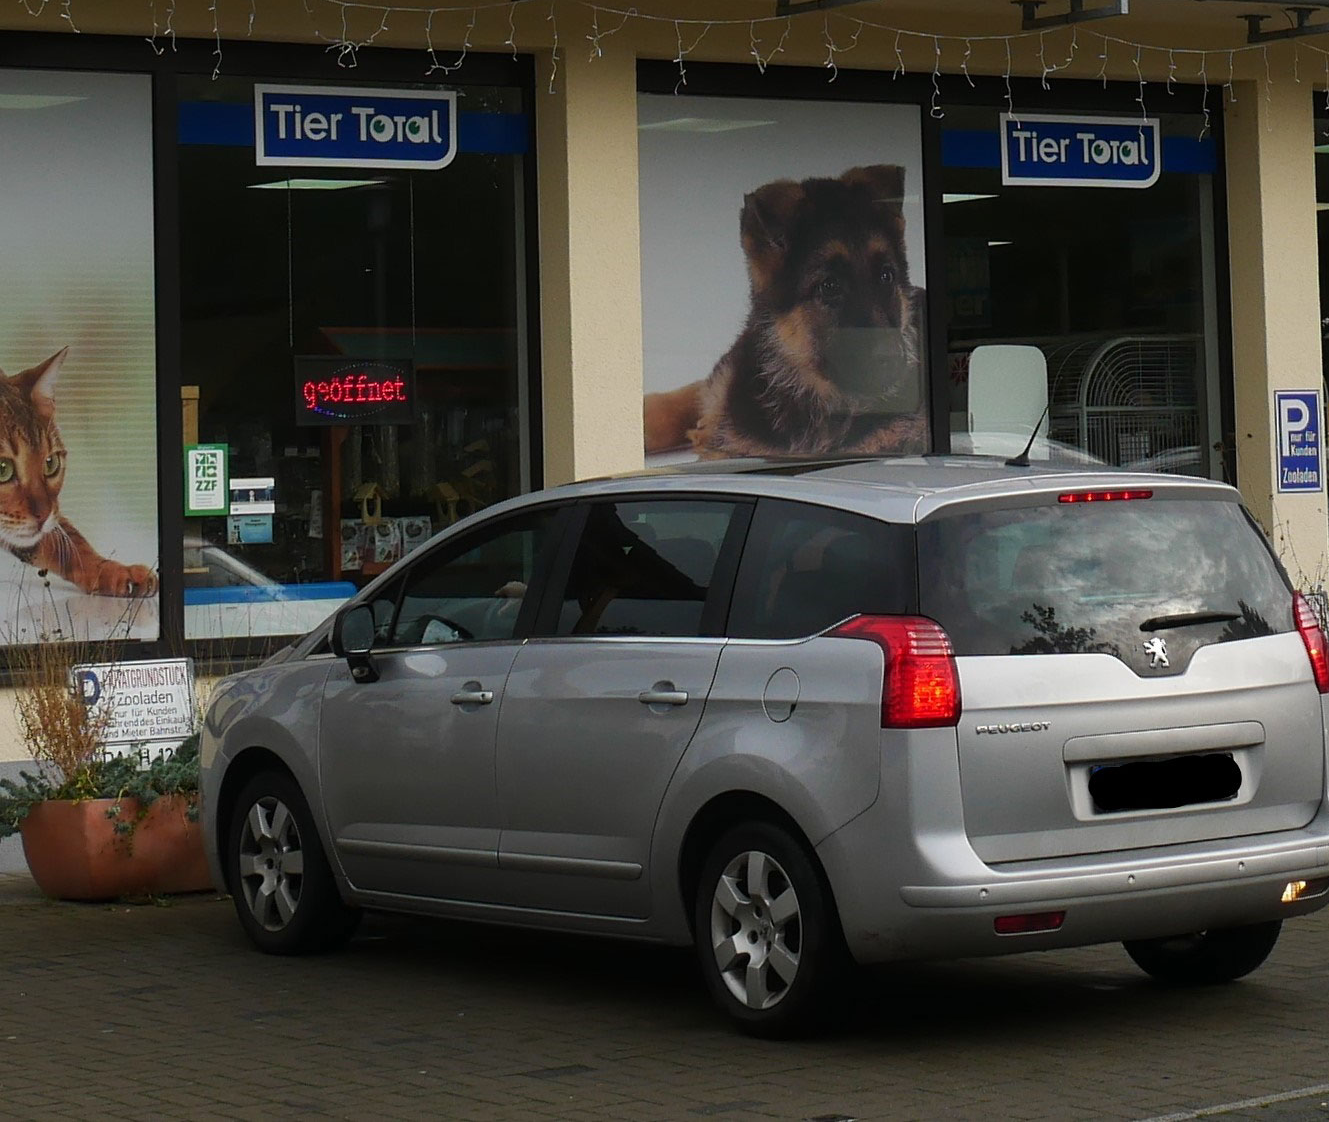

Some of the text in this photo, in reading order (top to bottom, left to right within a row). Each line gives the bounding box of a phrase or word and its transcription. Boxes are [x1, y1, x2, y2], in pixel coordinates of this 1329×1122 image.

[270, 104, 443, 144] Tier Total
[1012, 131, 1149, 166] Tier Total
[302, 374, 410, 410] geöffnet
[1280, 399, 1309, 457] P
[1290, 444, 1317, 457] Kunden
[1282, 468, 1318, 484] Zooladen
[195, 479, 218, 492] ZZF
[117, 690, 174, 707] Zooladen
[976, 722, 1052, 736] PEUGEOT
